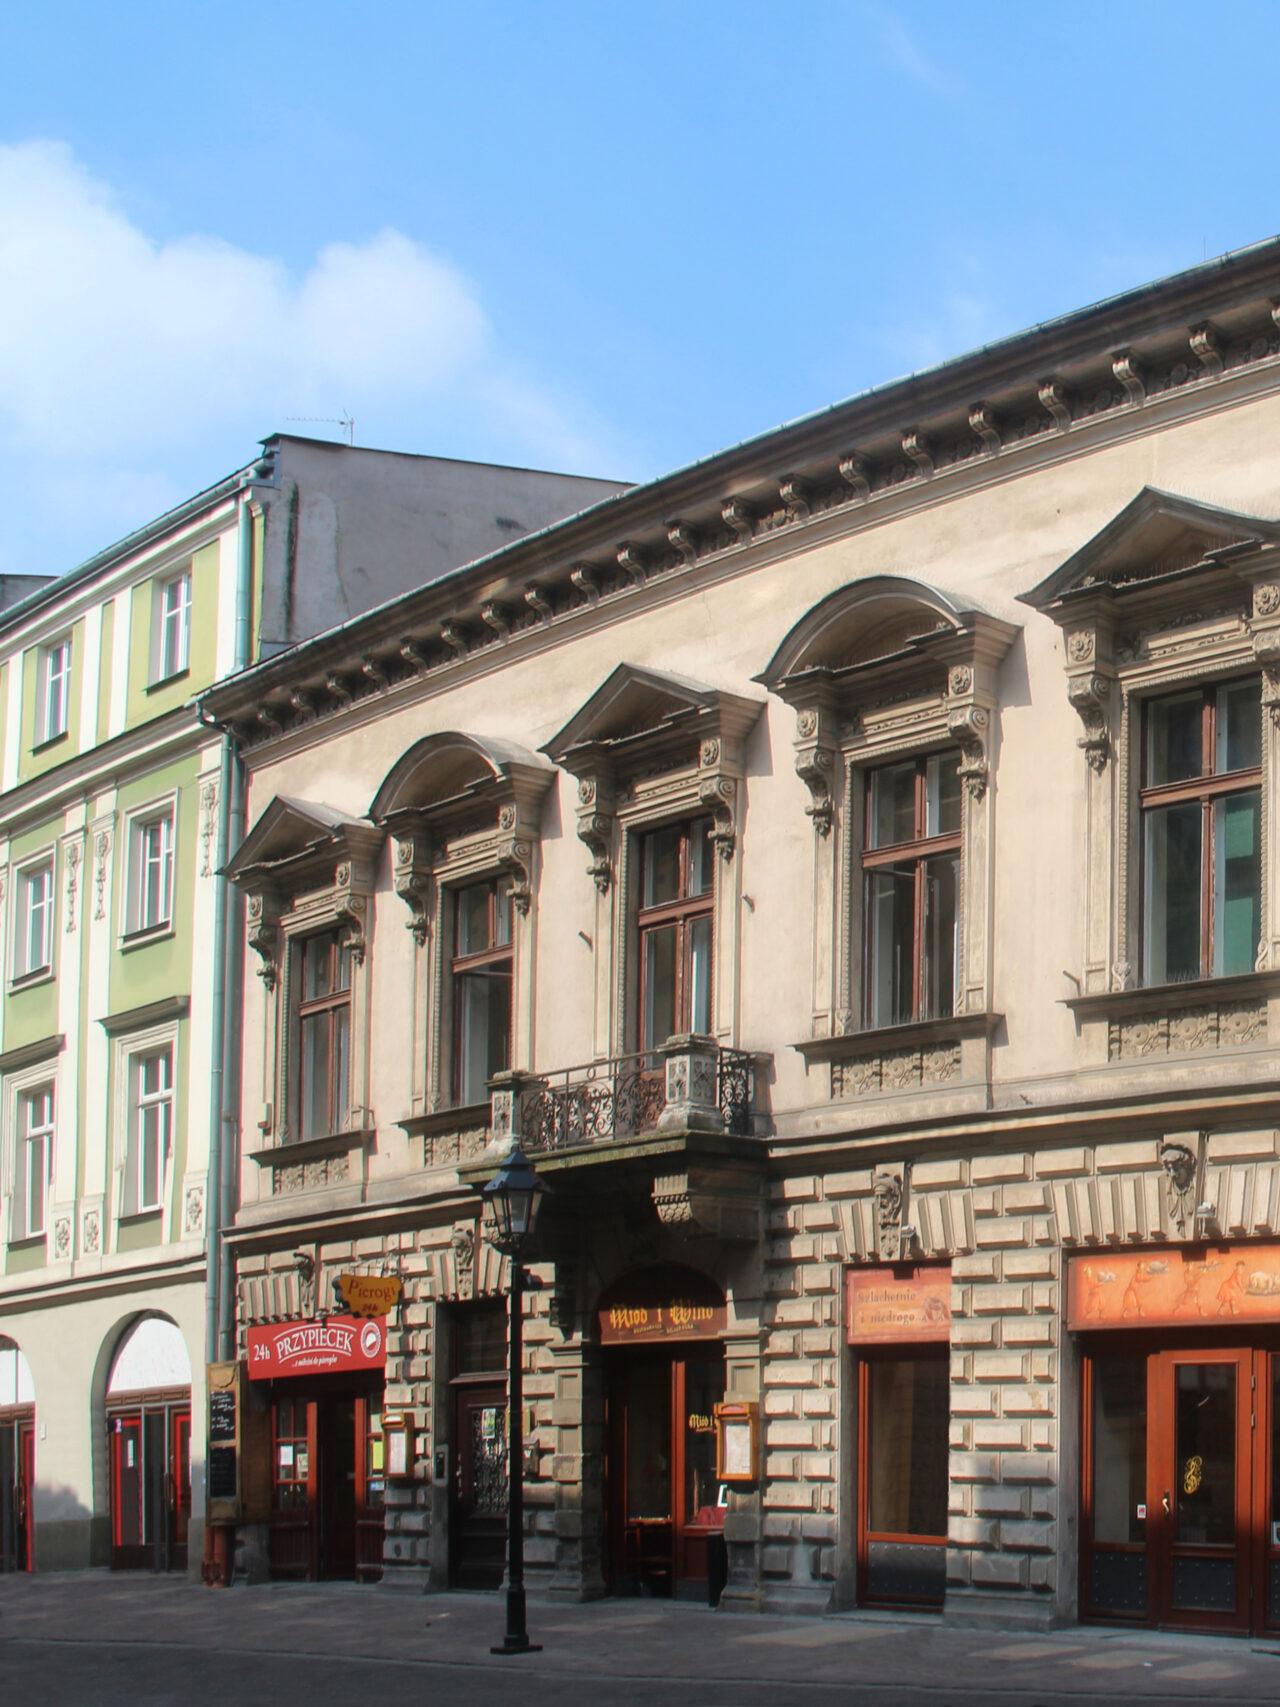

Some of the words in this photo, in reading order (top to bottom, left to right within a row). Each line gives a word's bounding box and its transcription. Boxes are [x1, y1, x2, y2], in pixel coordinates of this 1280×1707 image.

[348, 1279, 395, 1303] Pierogi
[254, 1343, 271, 1361] 24h
[276, 1328, 354, 1360] PRZYPIECEK
